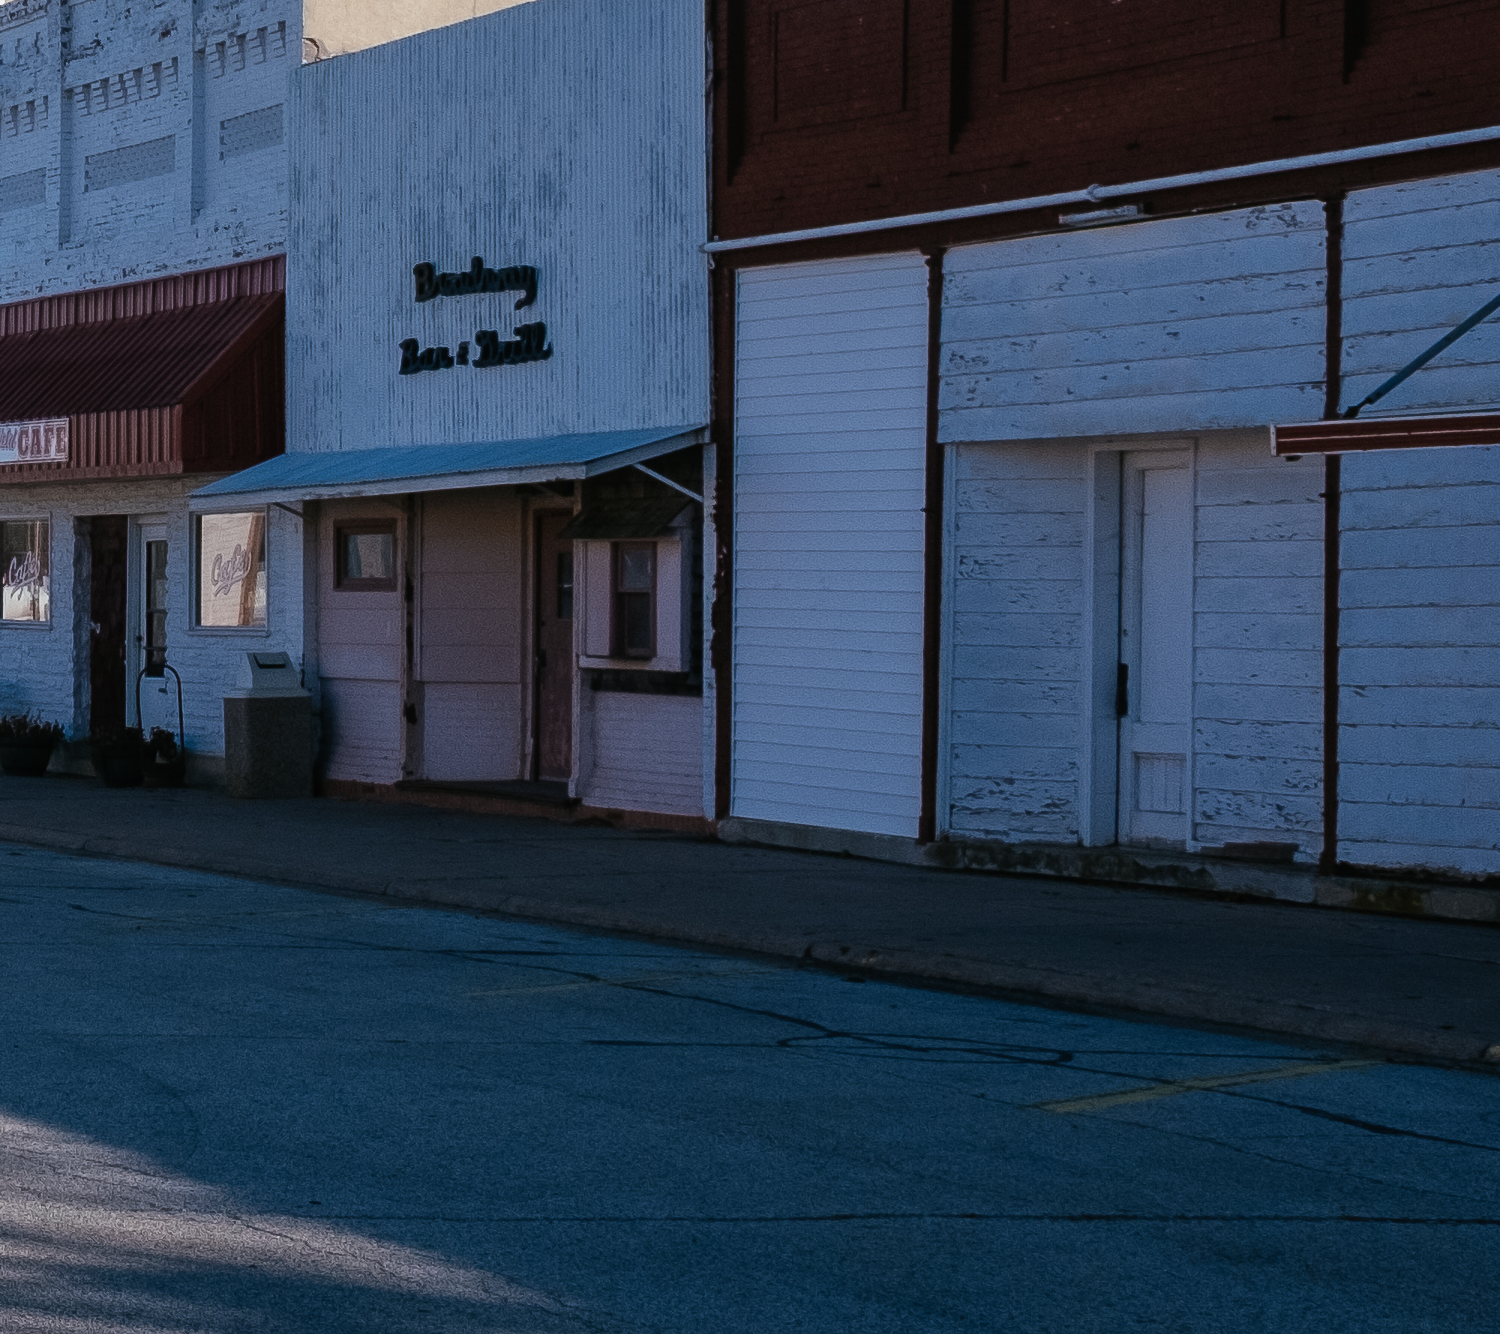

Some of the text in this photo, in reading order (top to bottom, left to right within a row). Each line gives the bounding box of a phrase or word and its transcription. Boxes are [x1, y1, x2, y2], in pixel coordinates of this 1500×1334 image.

[398, 338, 454, 375] Bar
[472, 321, 554, 368] Grill
[18, 424, 66, 459] CAFE
